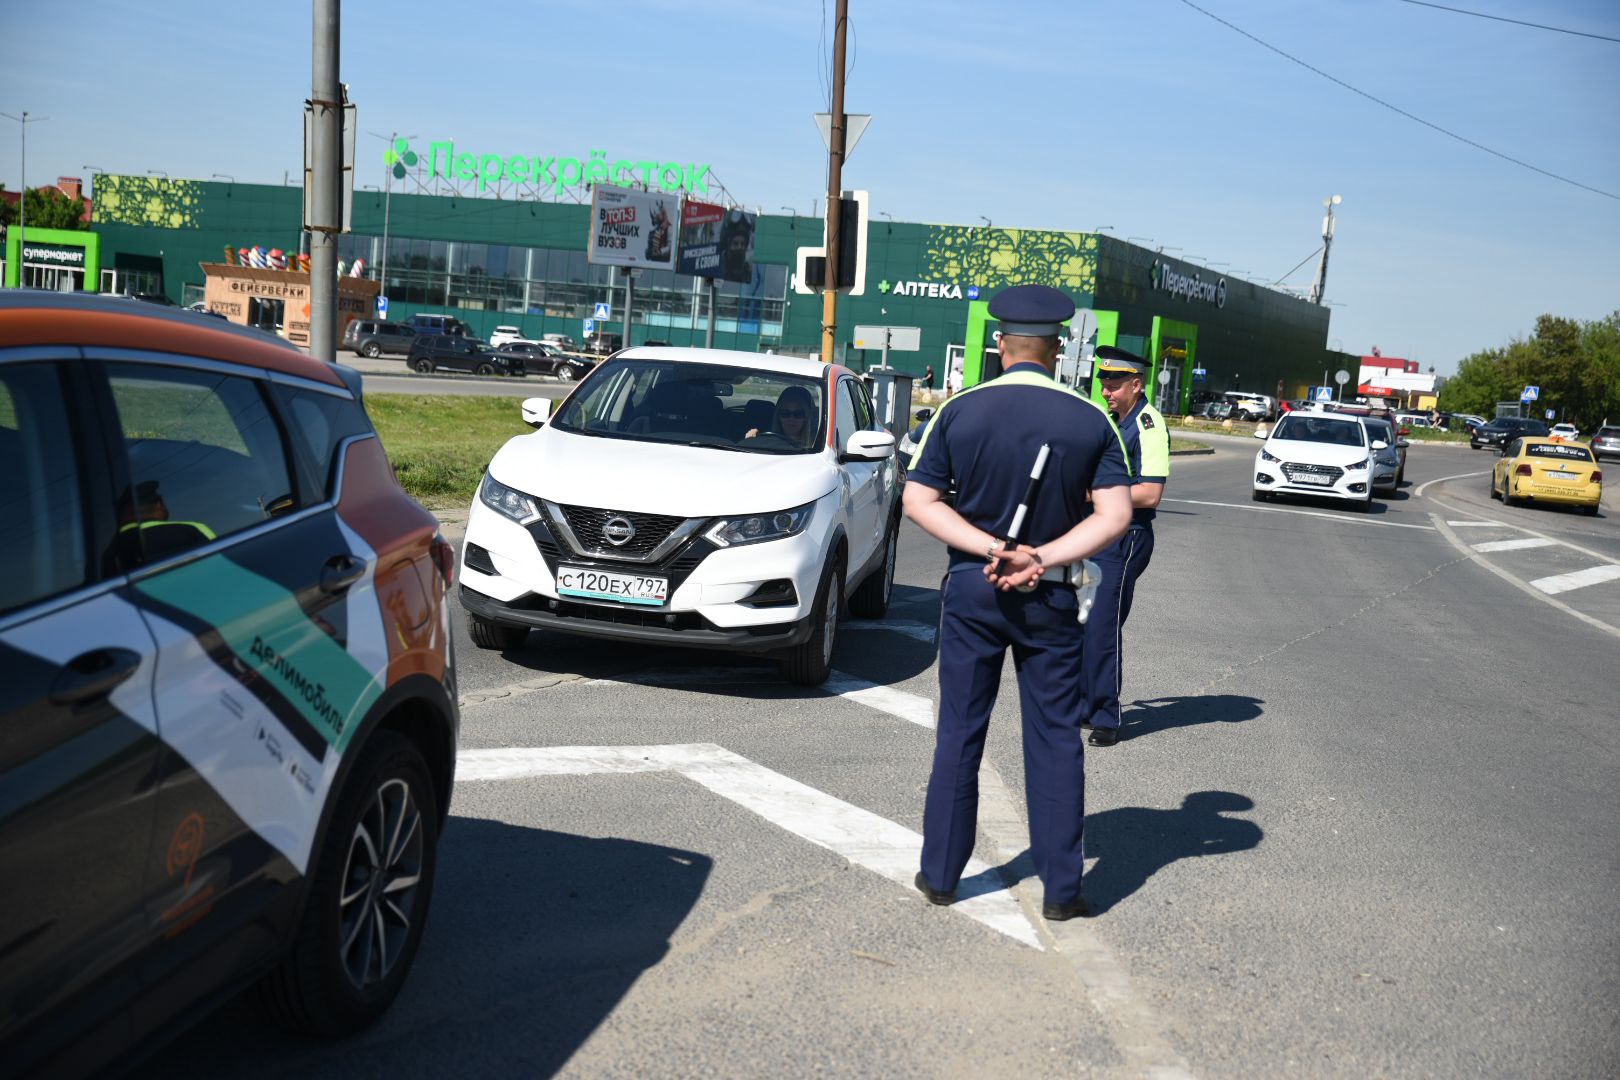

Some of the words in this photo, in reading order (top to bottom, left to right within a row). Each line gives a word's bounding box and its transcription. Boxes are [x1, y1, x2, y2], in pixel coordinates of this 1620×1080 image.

[428, 141, 711, 195] Перекрёсток
[607, 208, 634, 222] ТОП-3
[601, 222, 640, 238] ЛУЧШИХ
[598, 235, 627, 249] ВУЗОВ
[23, 247, 84, 262] супермаркет
[893, 281, 963, 299] АПТЕКА
[1161, 263, 1217, 303] Перекрёсток
[604, 527, 632, 535] NISSAN
[637, 577, 663, 593] 797
